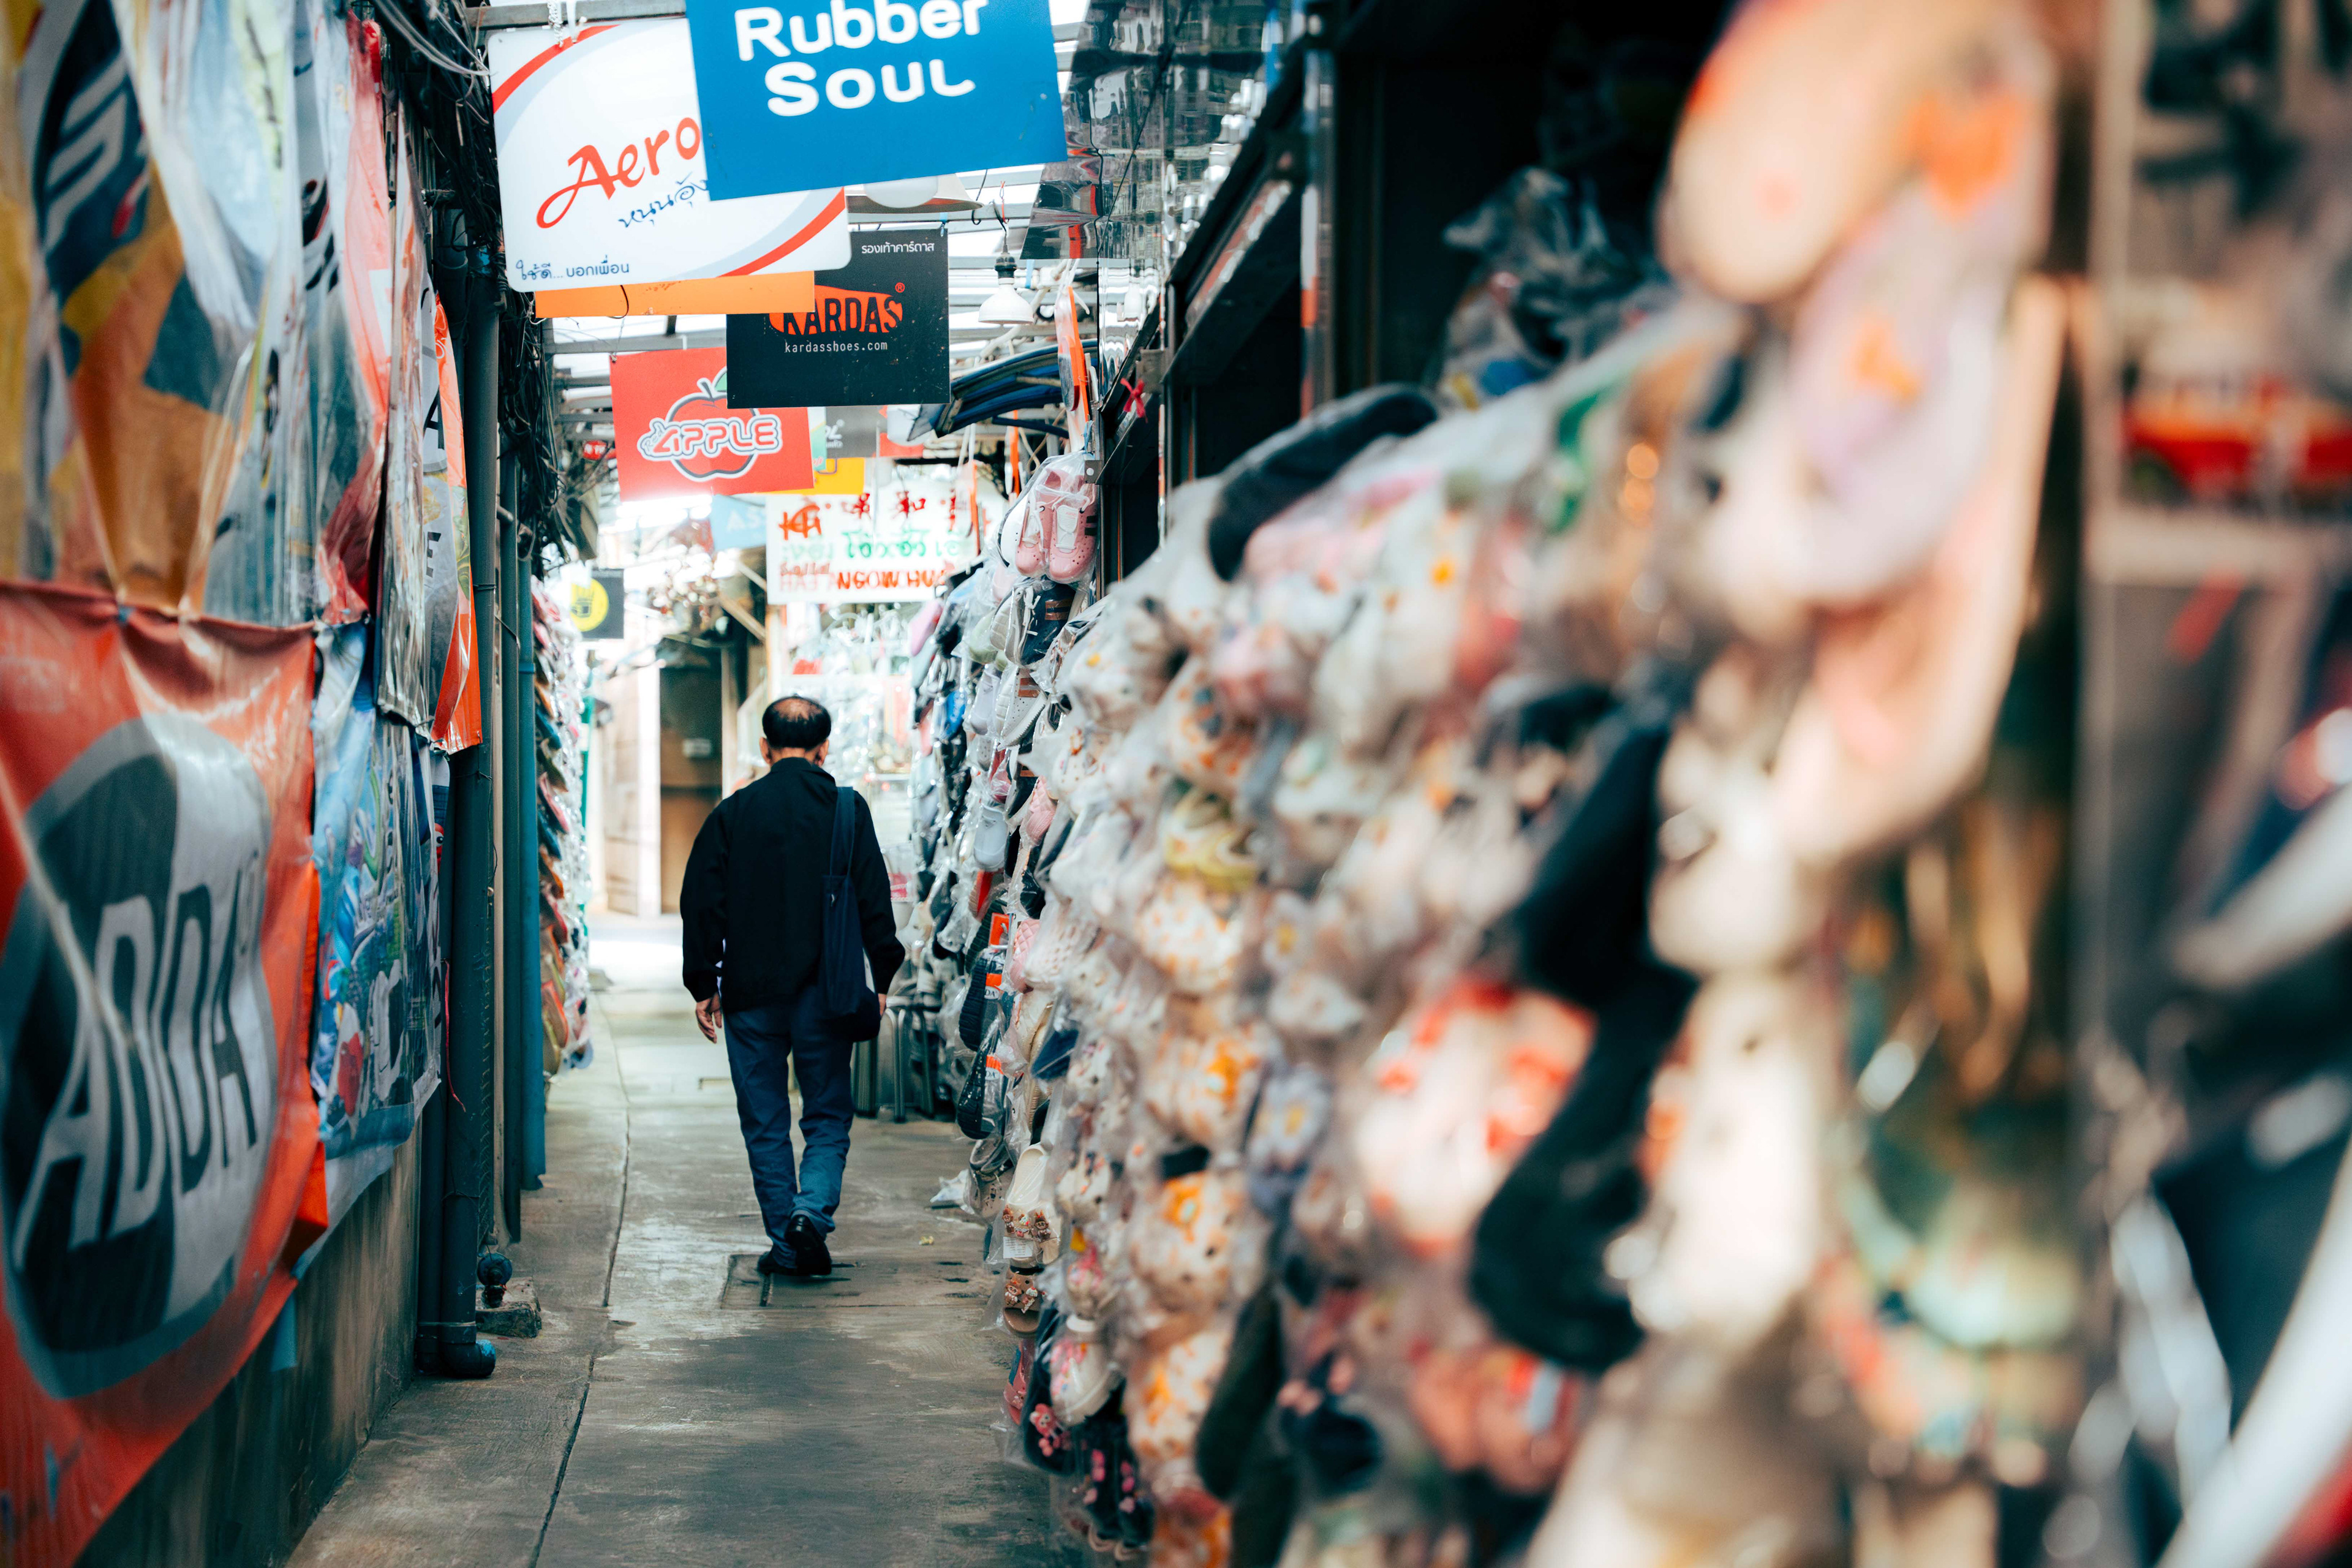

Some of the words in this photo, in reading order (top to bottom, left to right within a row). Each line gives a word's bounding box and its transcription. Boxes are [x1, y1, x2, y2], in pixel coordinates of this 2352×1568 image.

[734, 0, 989, 61] Rubber
[536, 117, 701, 229] Aero
[861, 241, 935, 254] รองเท้าคาร์ดาส
[566, 255, 630, 277] บอกเพื่อน
[785, 341, 888, 353] kardasshoes.com
[651, 420, 777, 454] APPLE
